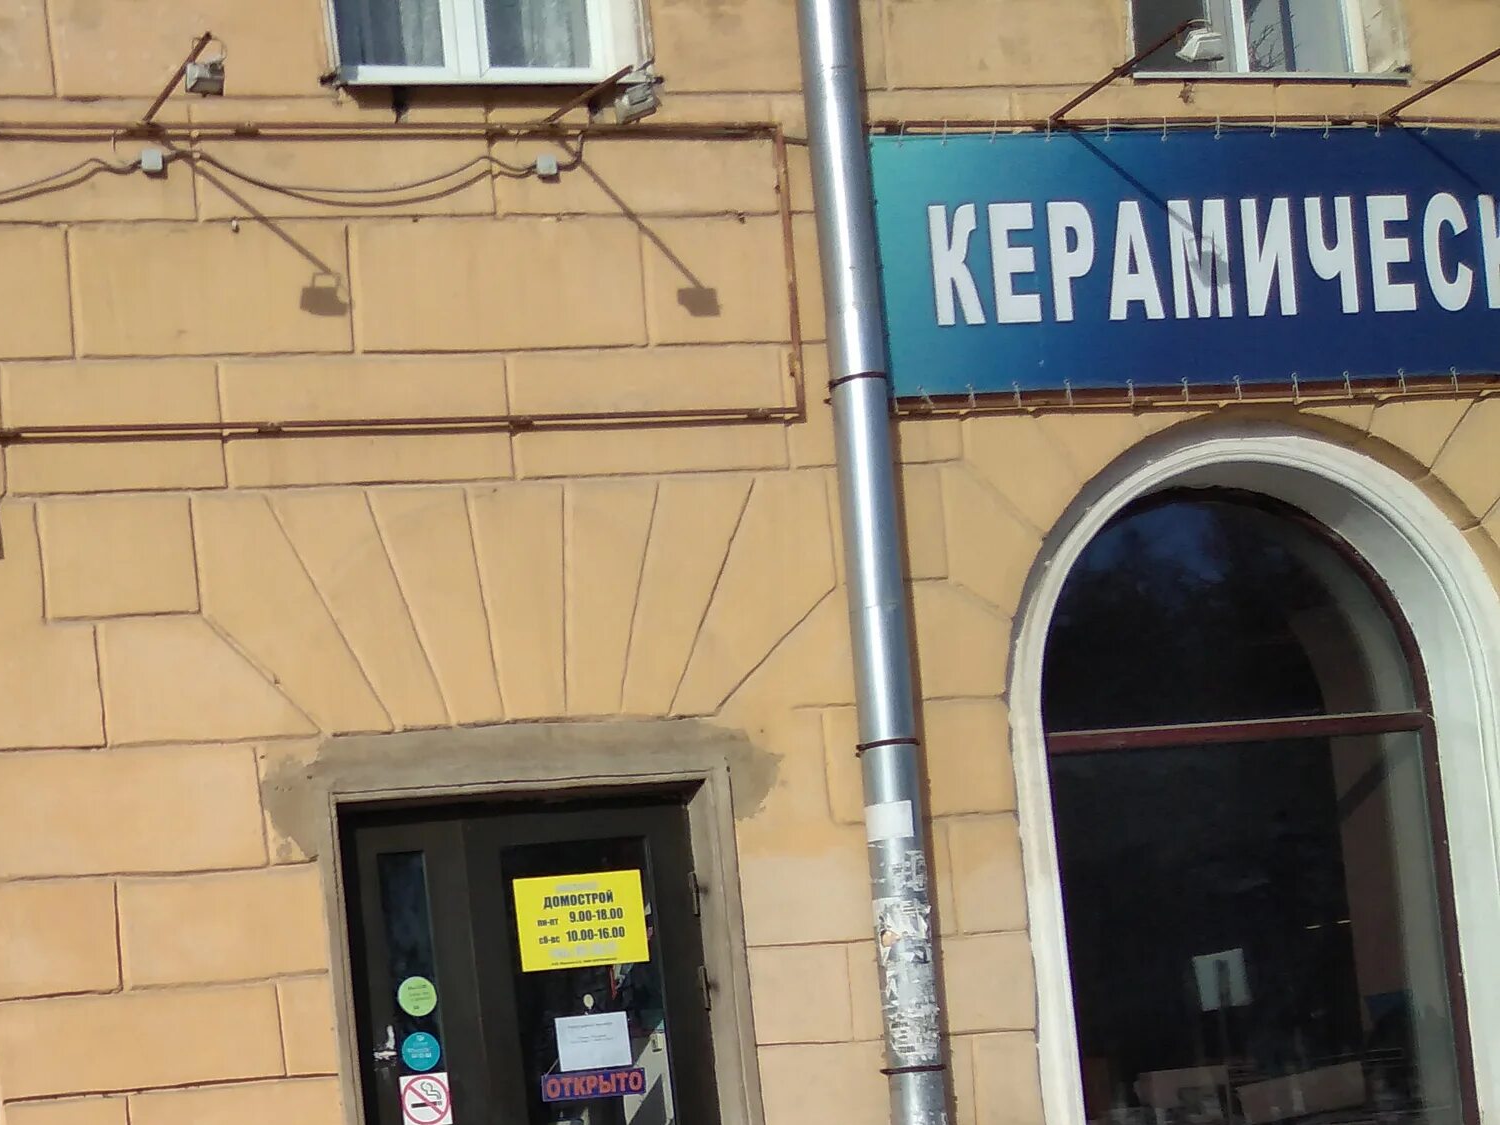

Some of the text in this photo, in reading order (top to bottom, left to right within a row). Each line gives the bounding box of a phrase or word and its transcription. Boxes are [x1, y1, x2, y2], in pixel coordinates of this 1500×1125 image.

[543, 889, 614, 909] ДОМОСТРОЙ
[569, 907, 624, 923] 9.00-18.00
[566, 926, 625, 943] 10.00-16.00
[546, 1071, 643, 1099] ОТКРЫТО
